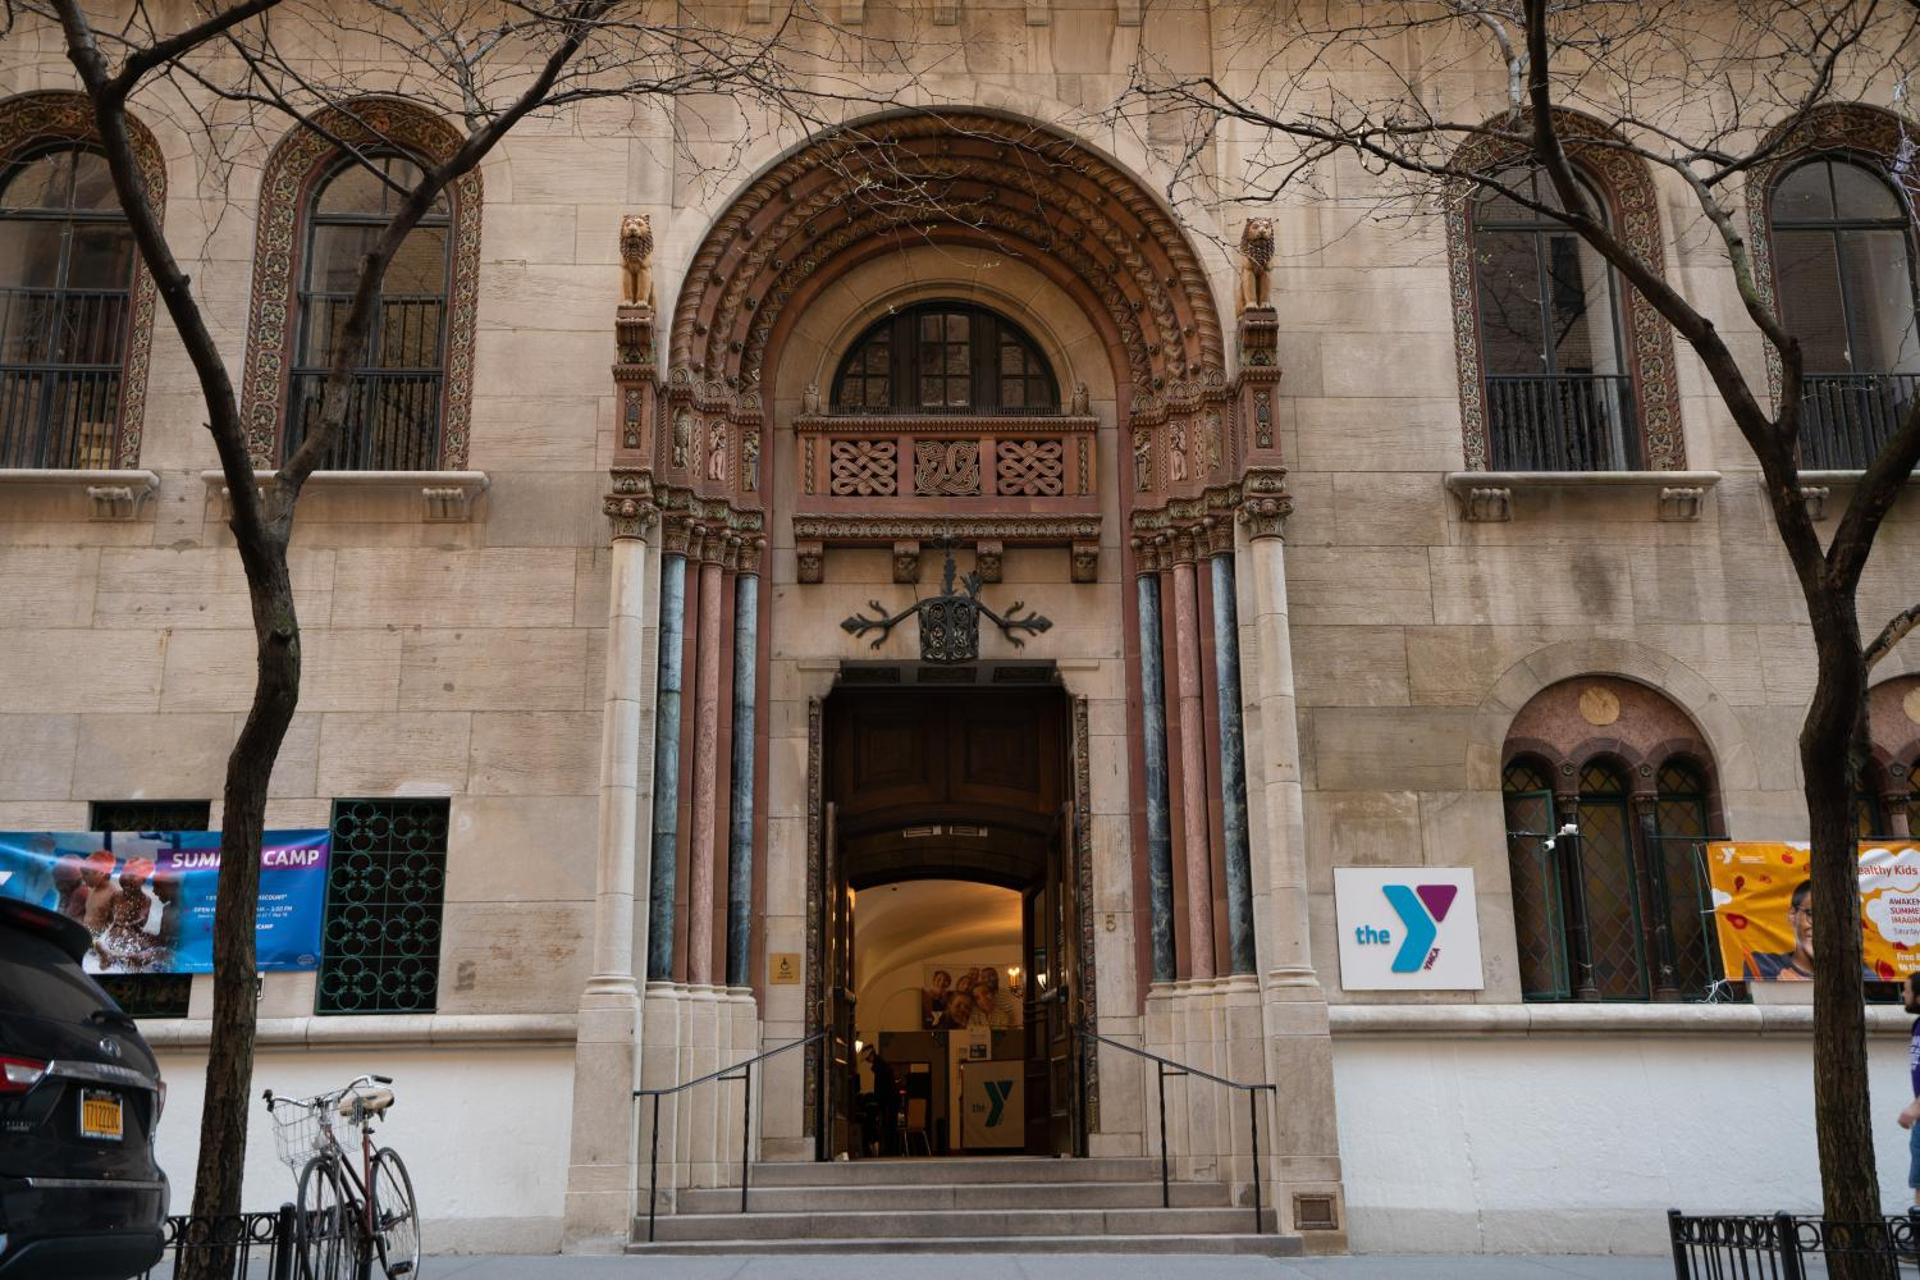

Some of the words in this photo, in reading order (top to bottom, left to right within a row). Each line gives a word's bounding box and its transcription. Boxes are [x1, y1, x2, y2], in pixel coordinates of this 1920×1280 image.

[171, 852, 221, 868] SUM
[263, 849, 320, 866] CAMP
[1857, 864, 1892, 878] ealthy
[1893, 864, 1918, 875] Kids
[1889, 907, 1920, 915] SUMME
[1355, 925, 1390, 945] the
